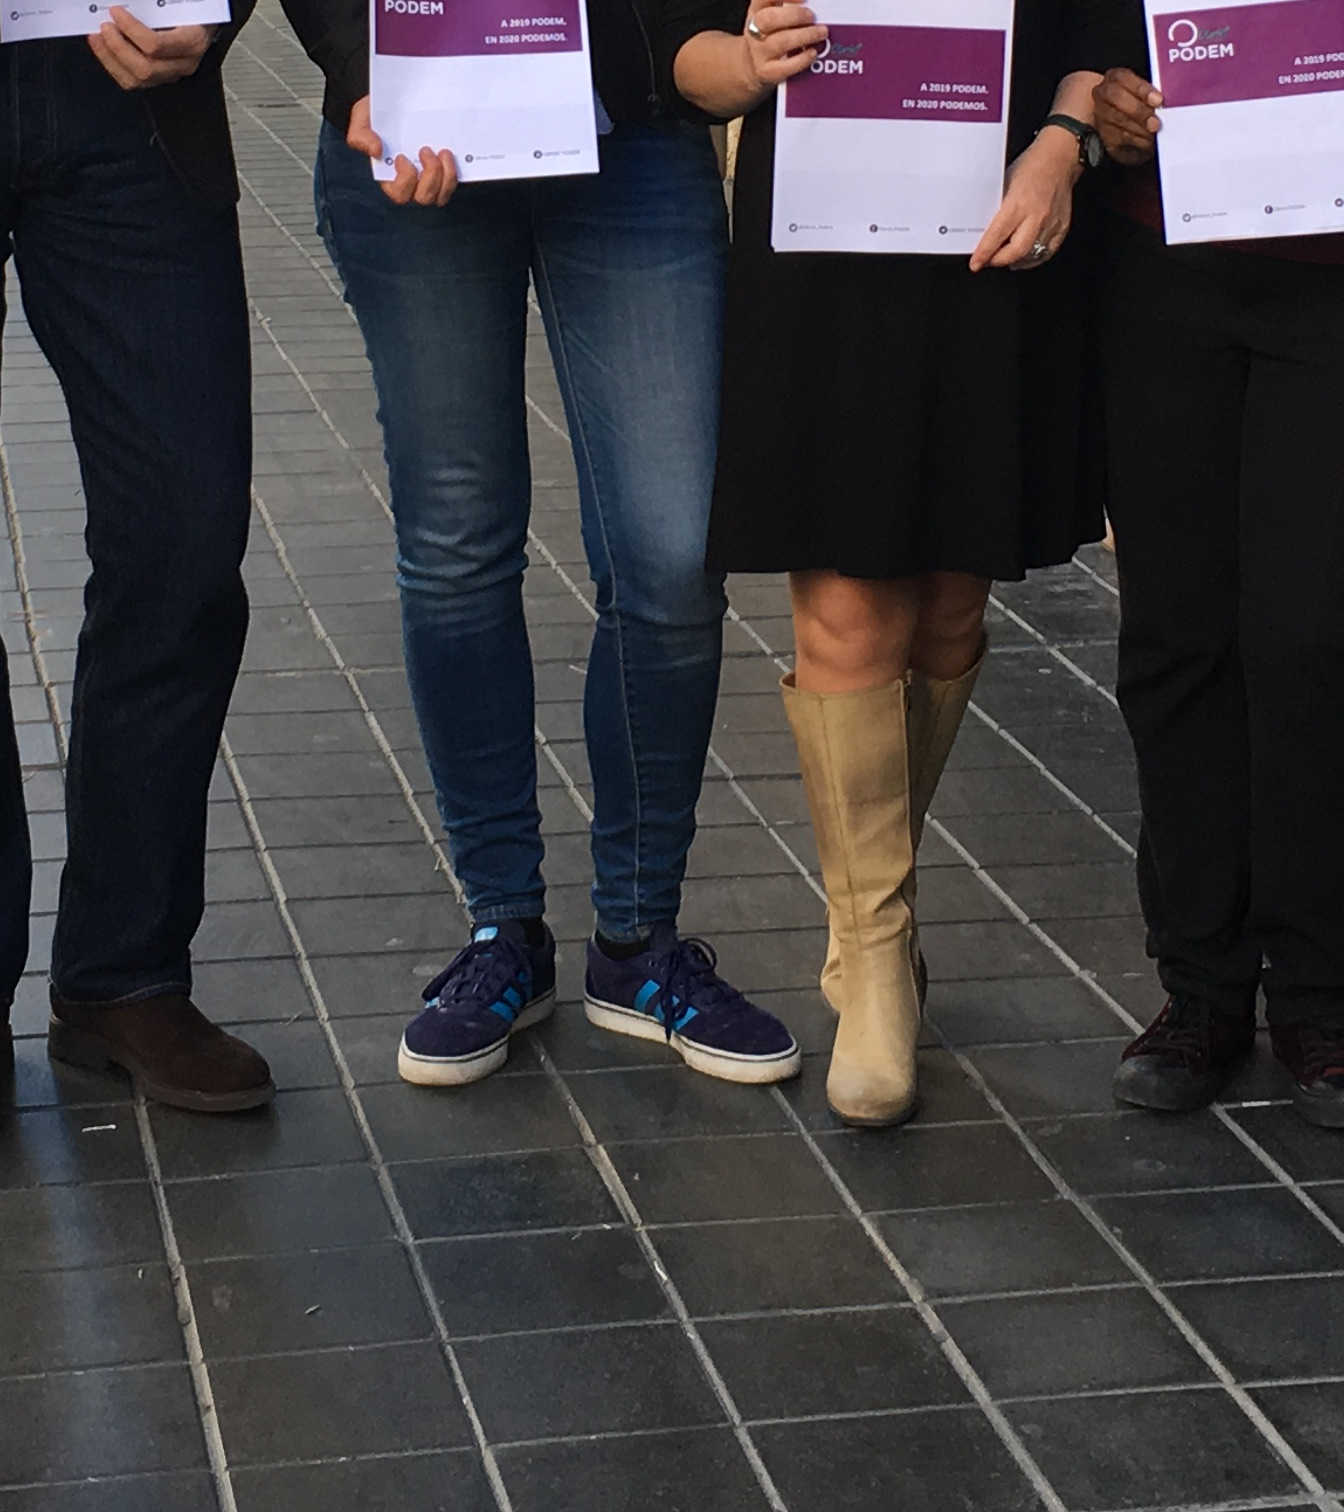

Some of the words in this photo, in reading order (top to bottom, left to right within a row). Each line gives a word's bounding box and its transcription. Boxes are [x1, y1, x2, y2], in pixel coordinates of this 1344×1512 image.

[500, 19, 508, 28] A
[484, 36, 497, 44] EN
[1168, 42, 1234, 63] PODEM
[1294, 56, 1302, 65] A
[810, 59, 864, 75] ODEM
[1278, 75, 1292, 85] EN
[920, 82, 928, 92] A
[902, 99, 915, 108] EN
